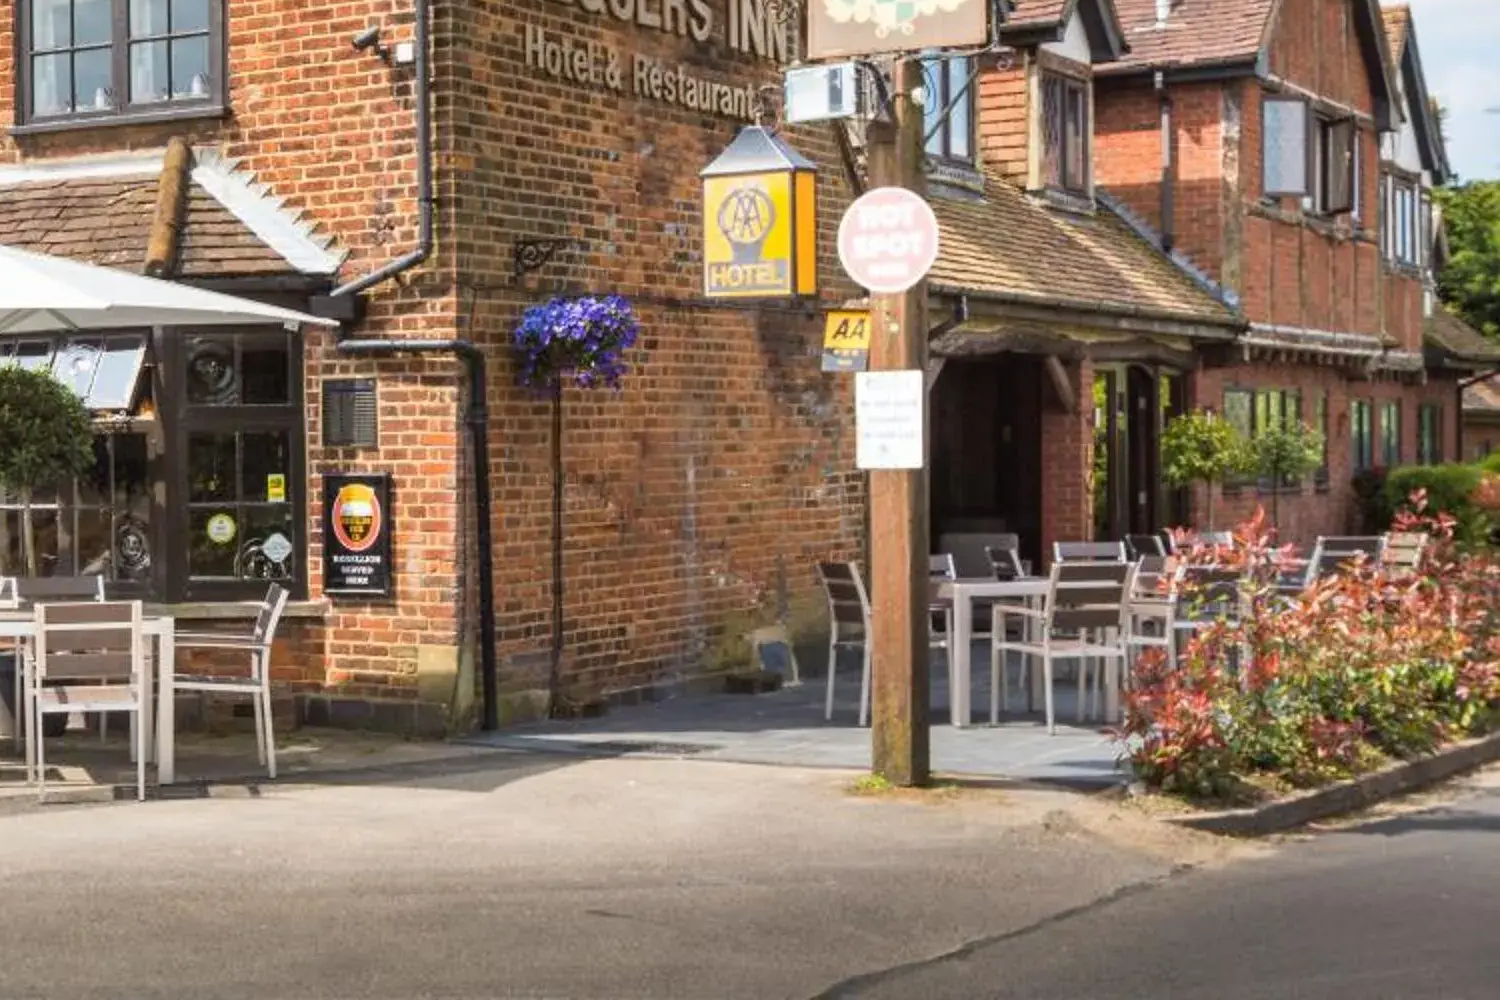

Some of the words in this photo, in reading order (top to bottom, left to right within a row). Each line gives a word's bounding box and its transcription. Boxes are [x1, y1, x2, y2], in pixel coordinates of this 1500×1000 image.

[524, 24, 597, 83] Hotel
[603, 49, 622, 90] &
[633, 53, 755, 118] Restaurant
[709, 260, 785, 287] HOTEL
[831, 317, 866, 340] AA
